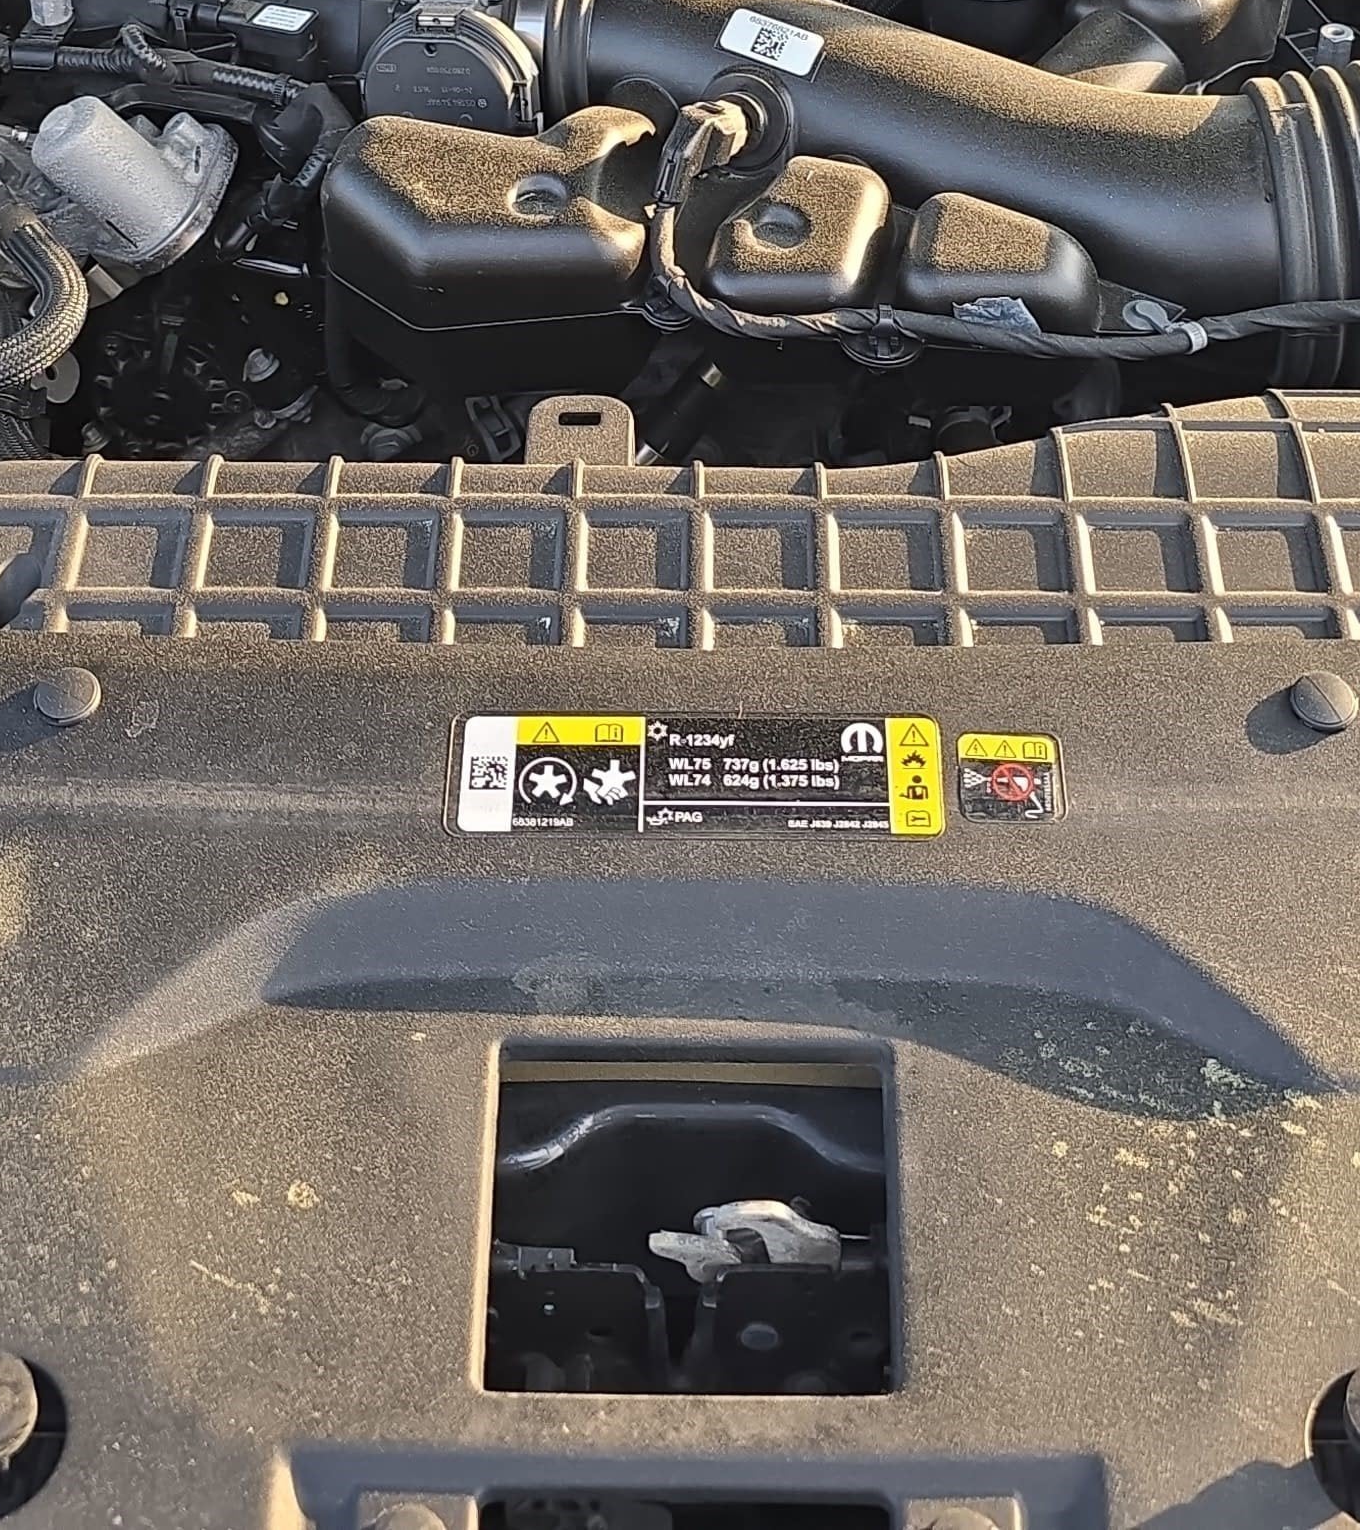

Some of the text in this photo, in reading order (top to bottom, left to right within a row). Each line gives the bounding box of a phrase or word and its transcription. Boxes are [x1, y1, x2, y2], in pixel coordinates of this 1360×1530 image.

[669, 733, 735, 749] R-1234yf
[668, 757, 840, 774] WL75 737g (1.625 lbs)
[668, 773, 840, 790] WL74 624g (1.375 lbs)
[674, 811, 703, 823] PAG
